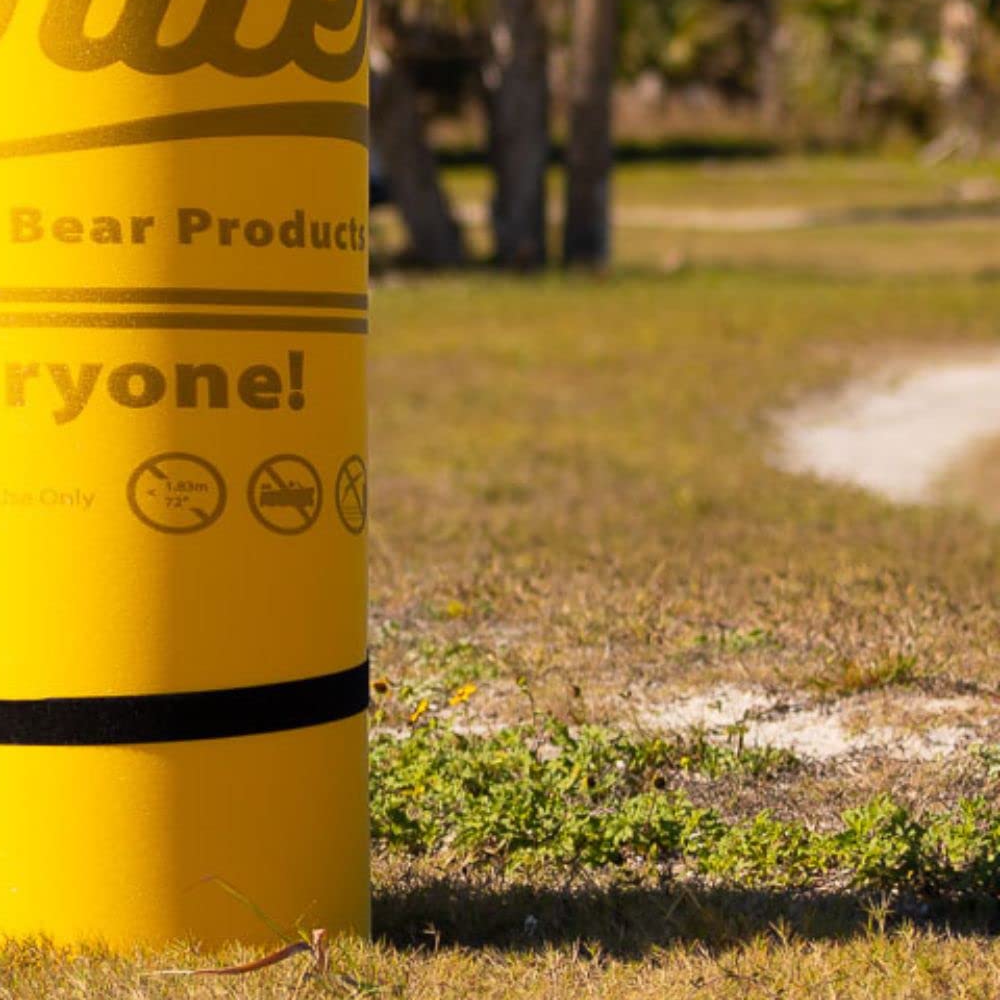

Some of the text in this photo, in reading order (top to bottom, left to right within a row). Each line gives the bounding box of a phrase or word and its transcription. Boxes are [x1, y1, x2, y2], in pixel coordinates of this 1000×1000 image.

[10, 207, 155, 246] Bear
[178, 207, 366, 252] Products
[39, 487, 98, 513] Only
